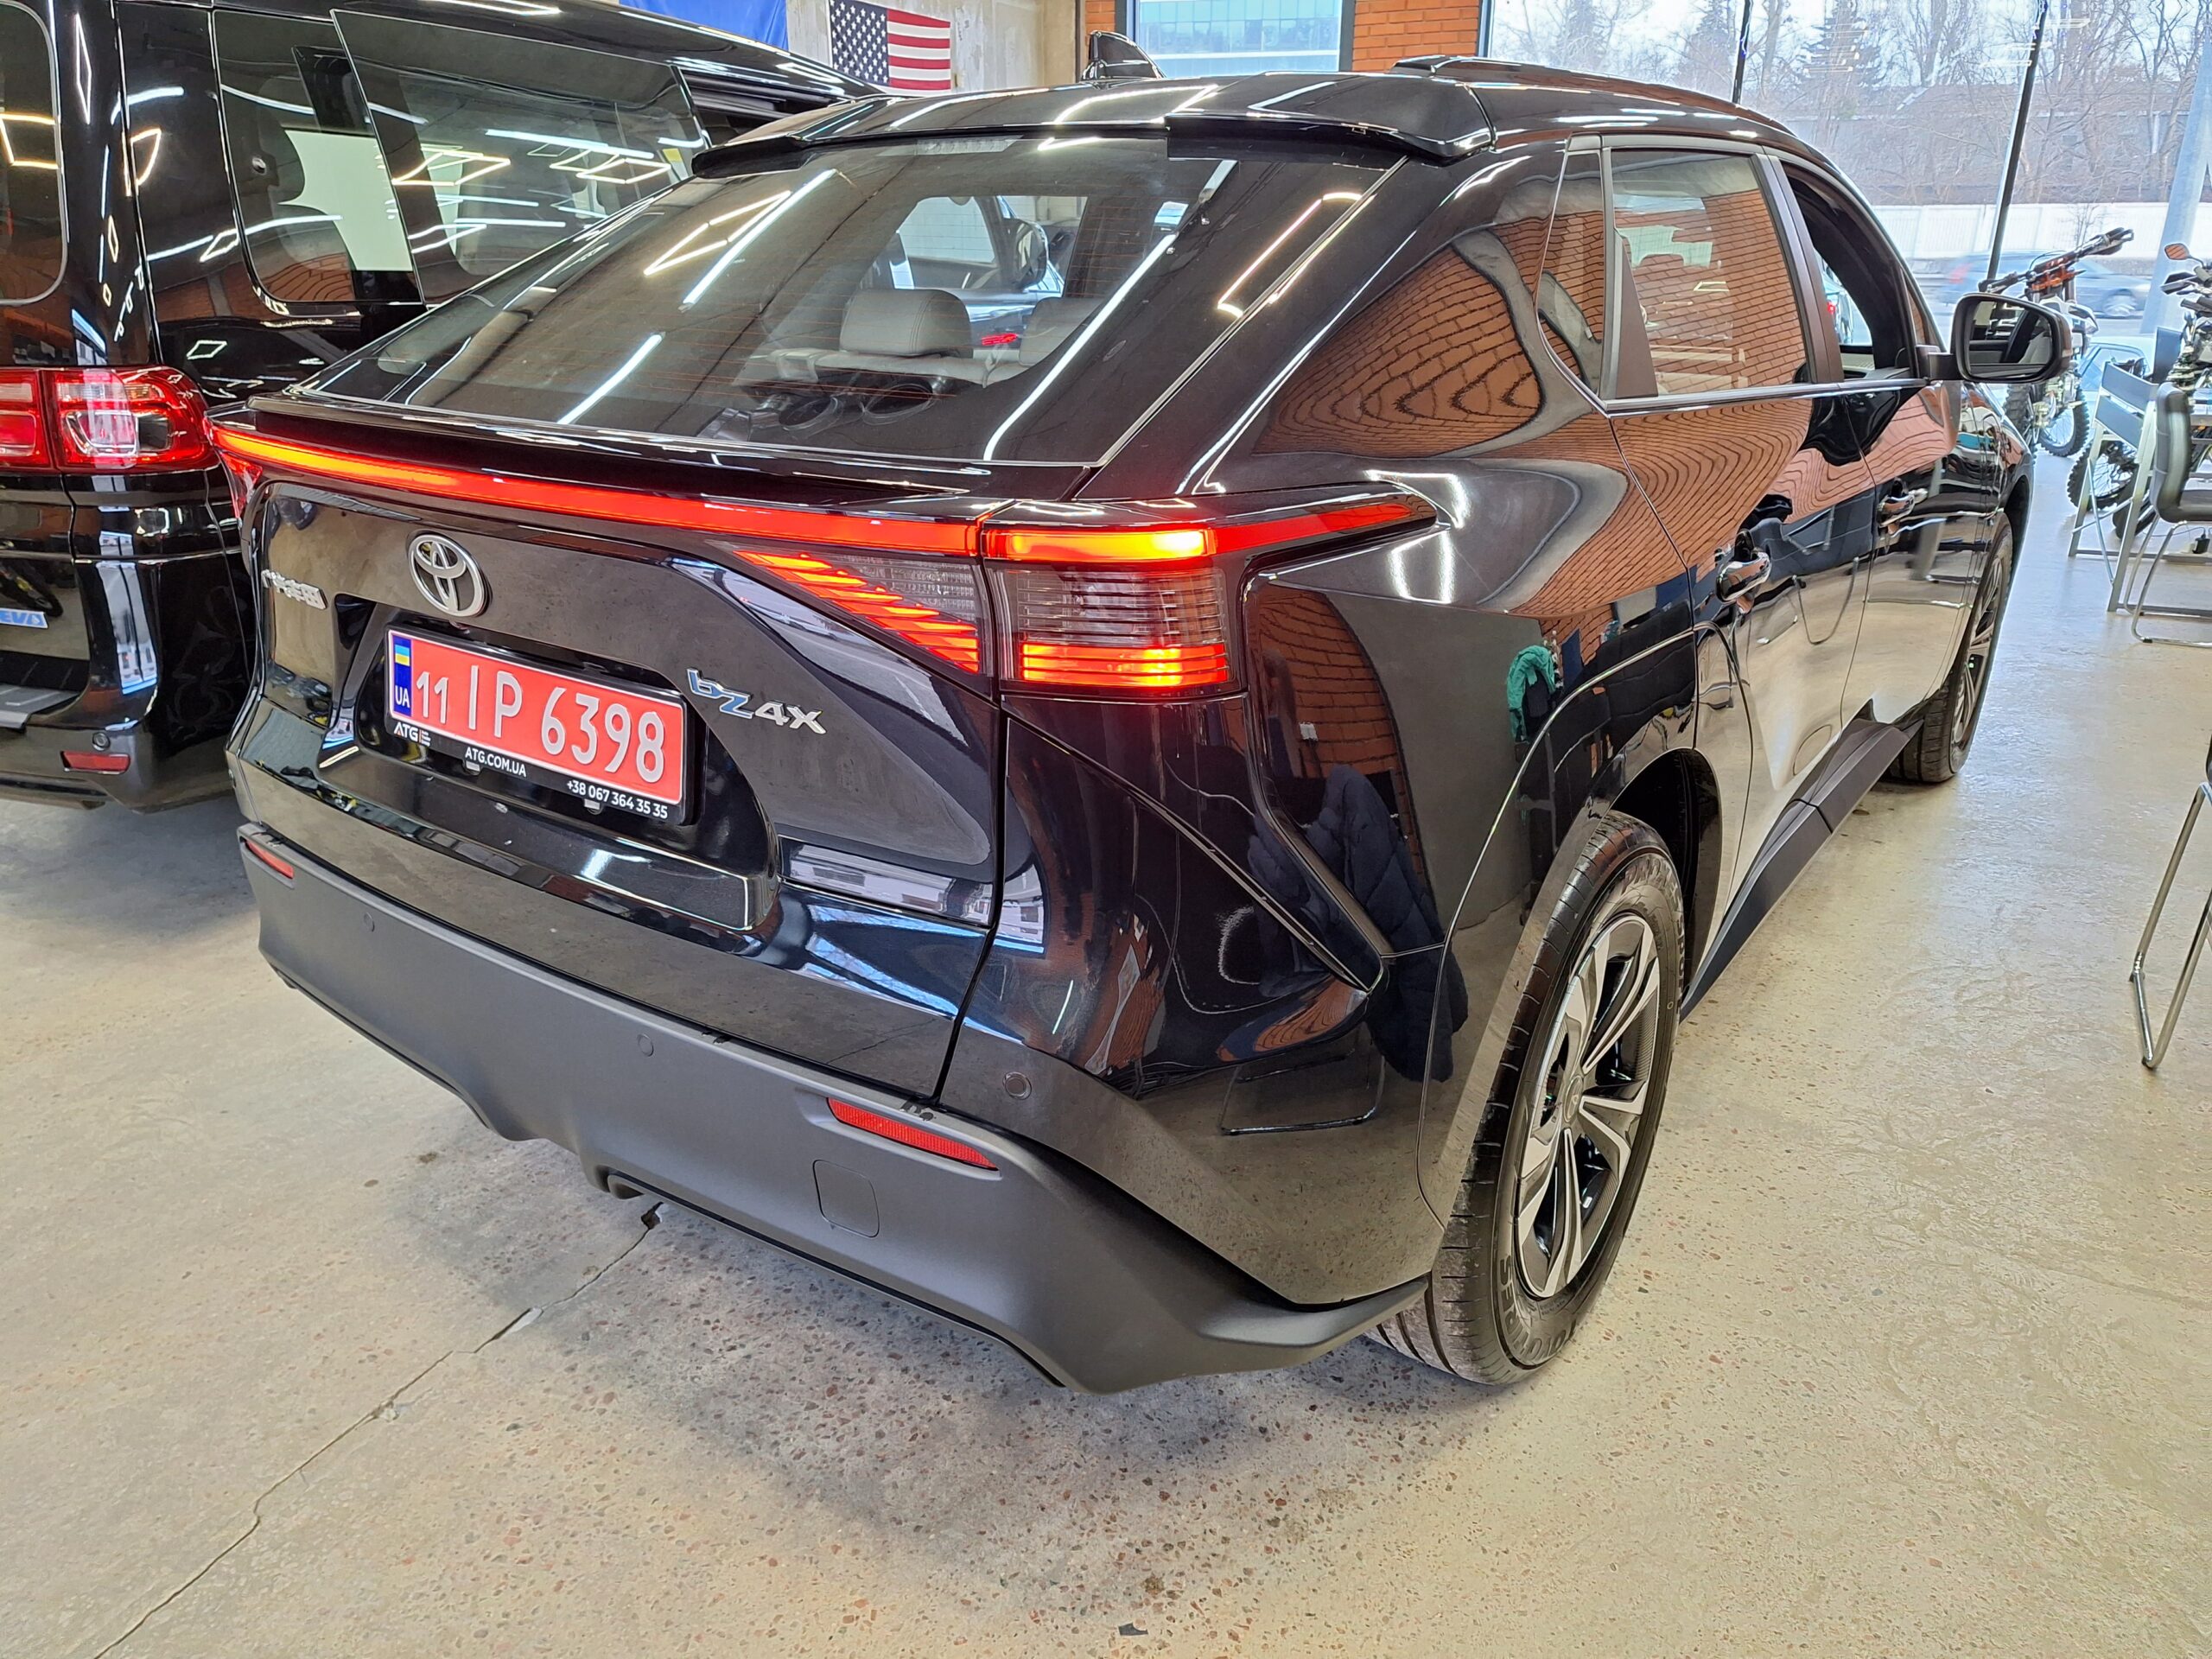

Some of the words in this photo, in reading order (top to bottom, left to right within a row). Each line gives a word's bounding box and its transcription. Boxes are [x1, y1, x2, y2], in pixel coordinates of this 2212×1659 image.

[395, 685, 410, 708] UA
[416, 671, 449, 724] 11
[541, 686, 664, 783] 6398
[465, 747, 527, 777] ATG.COM.UA
[567, 779, 587, 796] +38
[588, 785, 610, 802] 067
[611, 792, 634, 810] 364
[636, 798, 651, 814] 35
[652, 804, 668, 819] 35
